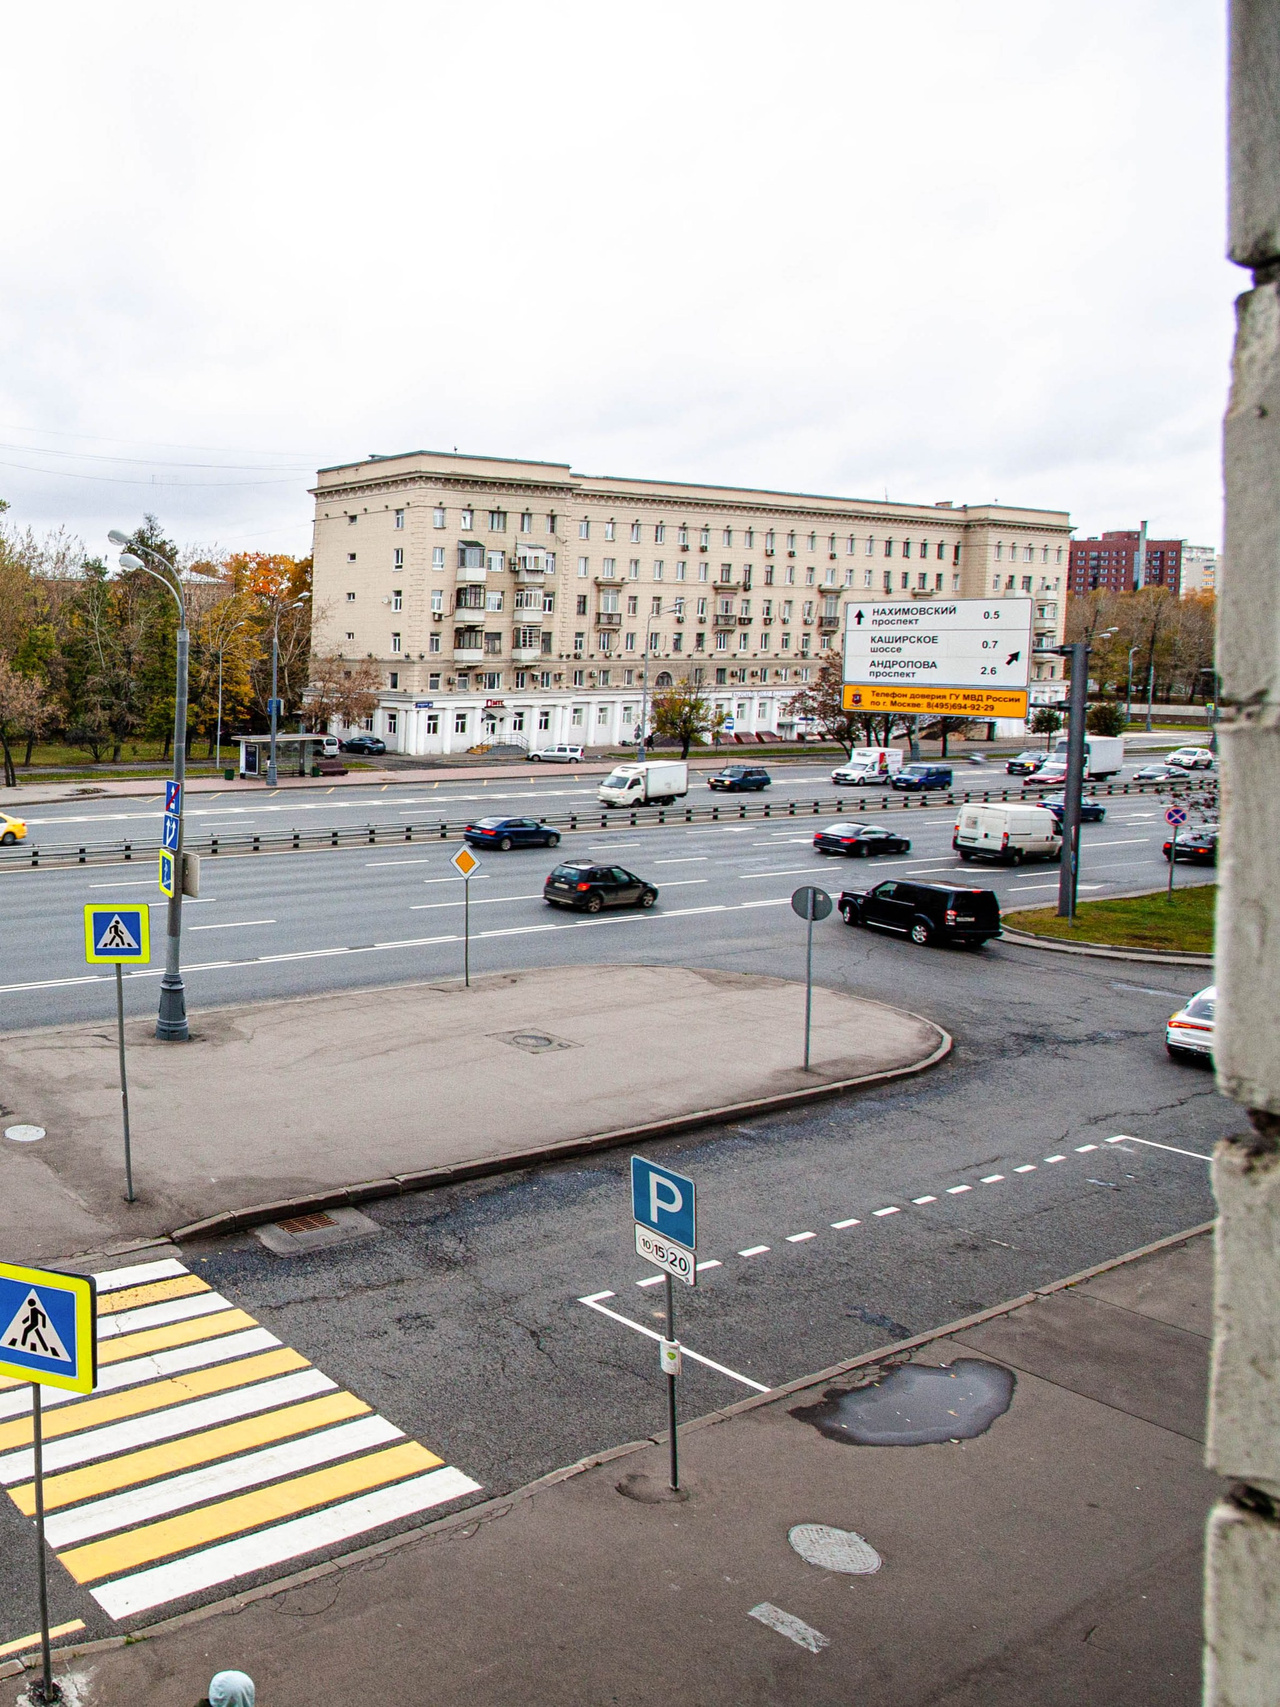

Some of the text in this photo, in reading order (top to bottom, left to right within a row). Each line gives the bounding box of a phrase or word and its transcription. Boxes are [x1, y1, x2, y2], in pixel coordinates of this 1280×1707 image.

[872, 605, 957, 616] НАХИМОВСКИЙ
[983, 610, 1000, 620] 0.5
[871, 618, 919, 627] проспект
[870, 635, 939, 644] КАШИРСКОЕ
[982, 640, 999, 649] 0.7
[870, 646, 902, 654] шоссе
[869, 660, 937, 670] АНДРОПОВА
[869, 670, 916, 679] проспект
[980, 666, 997, 675] 2.6
[871, 690, 1021, 703] Телефон доверия ГУ МВД России
[889, 700, 924, 709] Москве:
[926, 701, 995, 711] 8(495)694-92-29
[649, 1171, 683, 1224] P
[641, 1238, 688, 1273] 10 15 20
